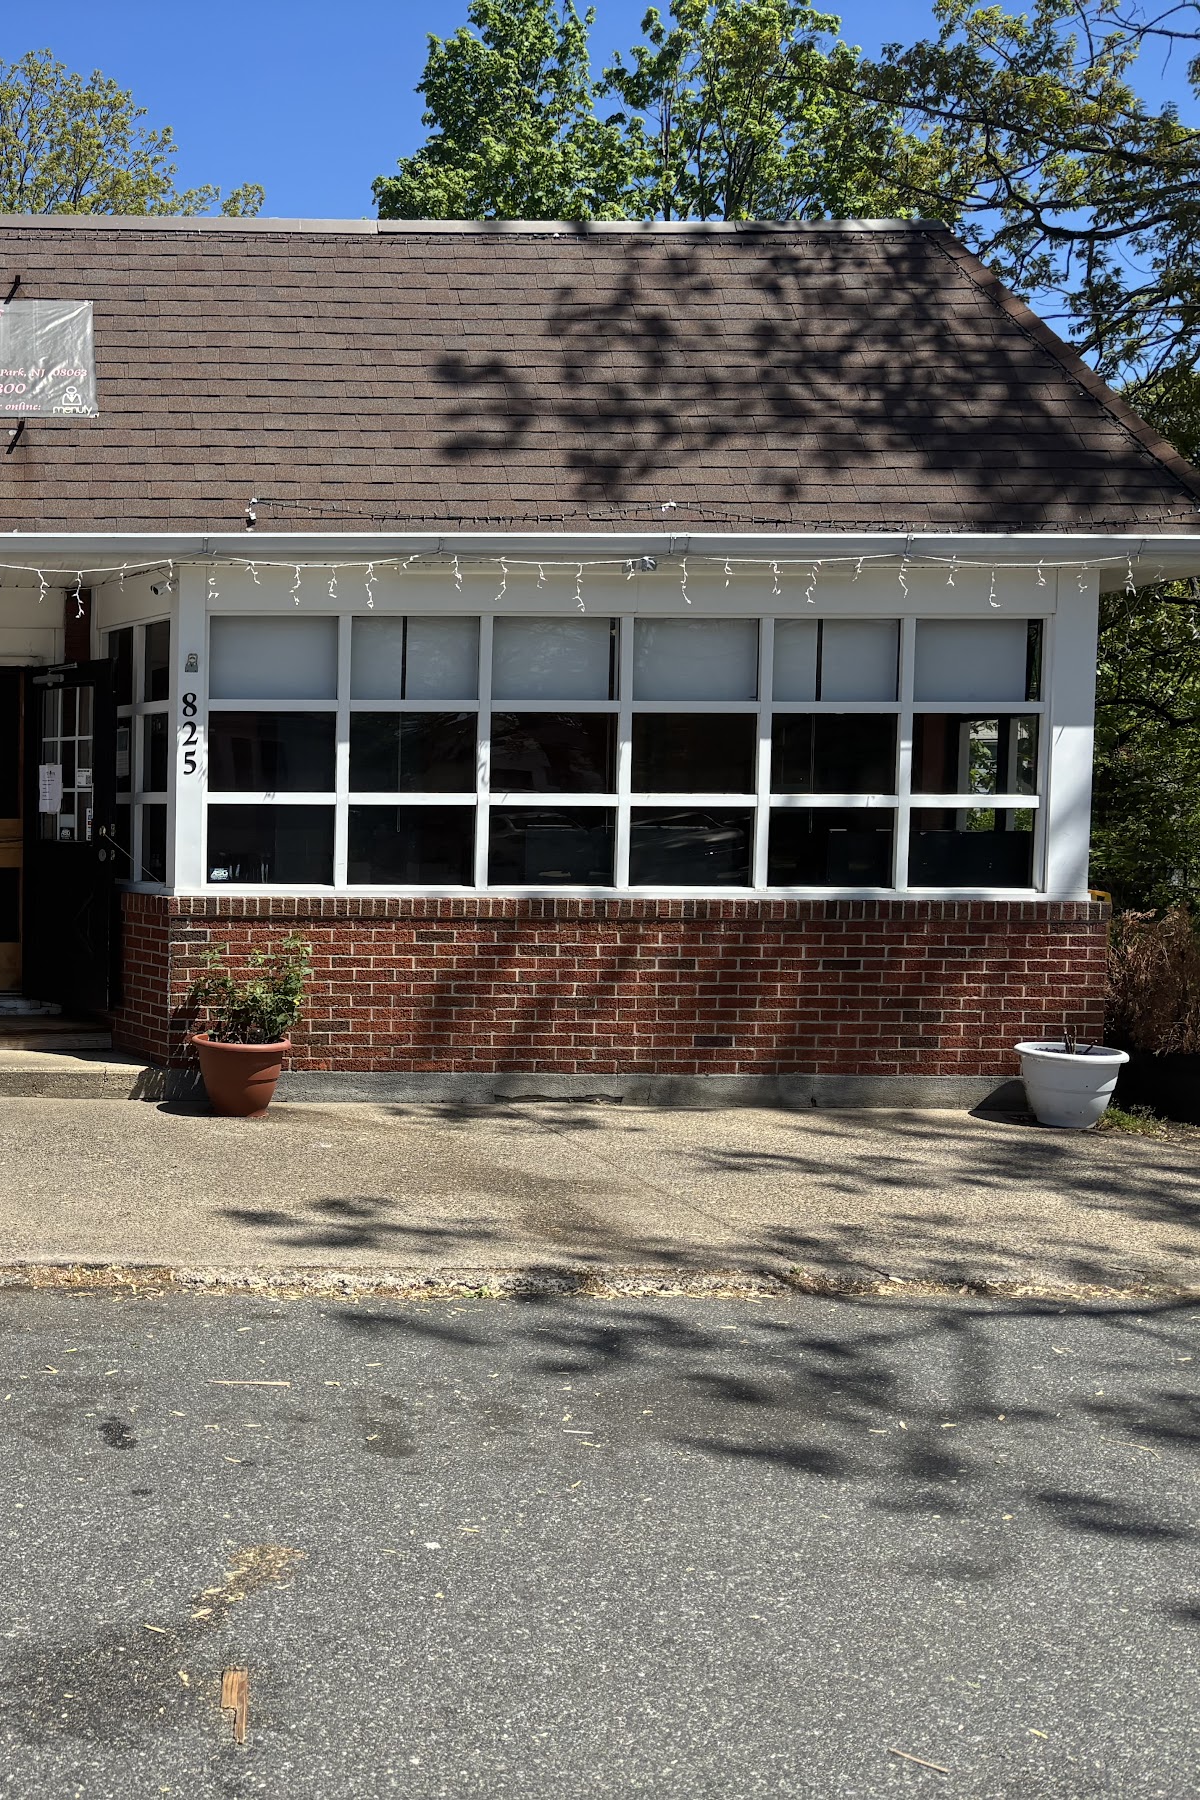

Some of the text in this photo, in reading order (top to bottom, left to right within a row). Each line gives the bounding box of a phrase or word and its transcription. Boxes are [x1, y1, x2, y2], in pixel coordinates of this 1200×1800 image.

[0, 368, 27, 378] Park,
[31, 368, 46, 377] NJ
[52, 368, 88, 377] 08063
[5, 401, 42, 411] online:
[182, 692, 199, 775] 825
